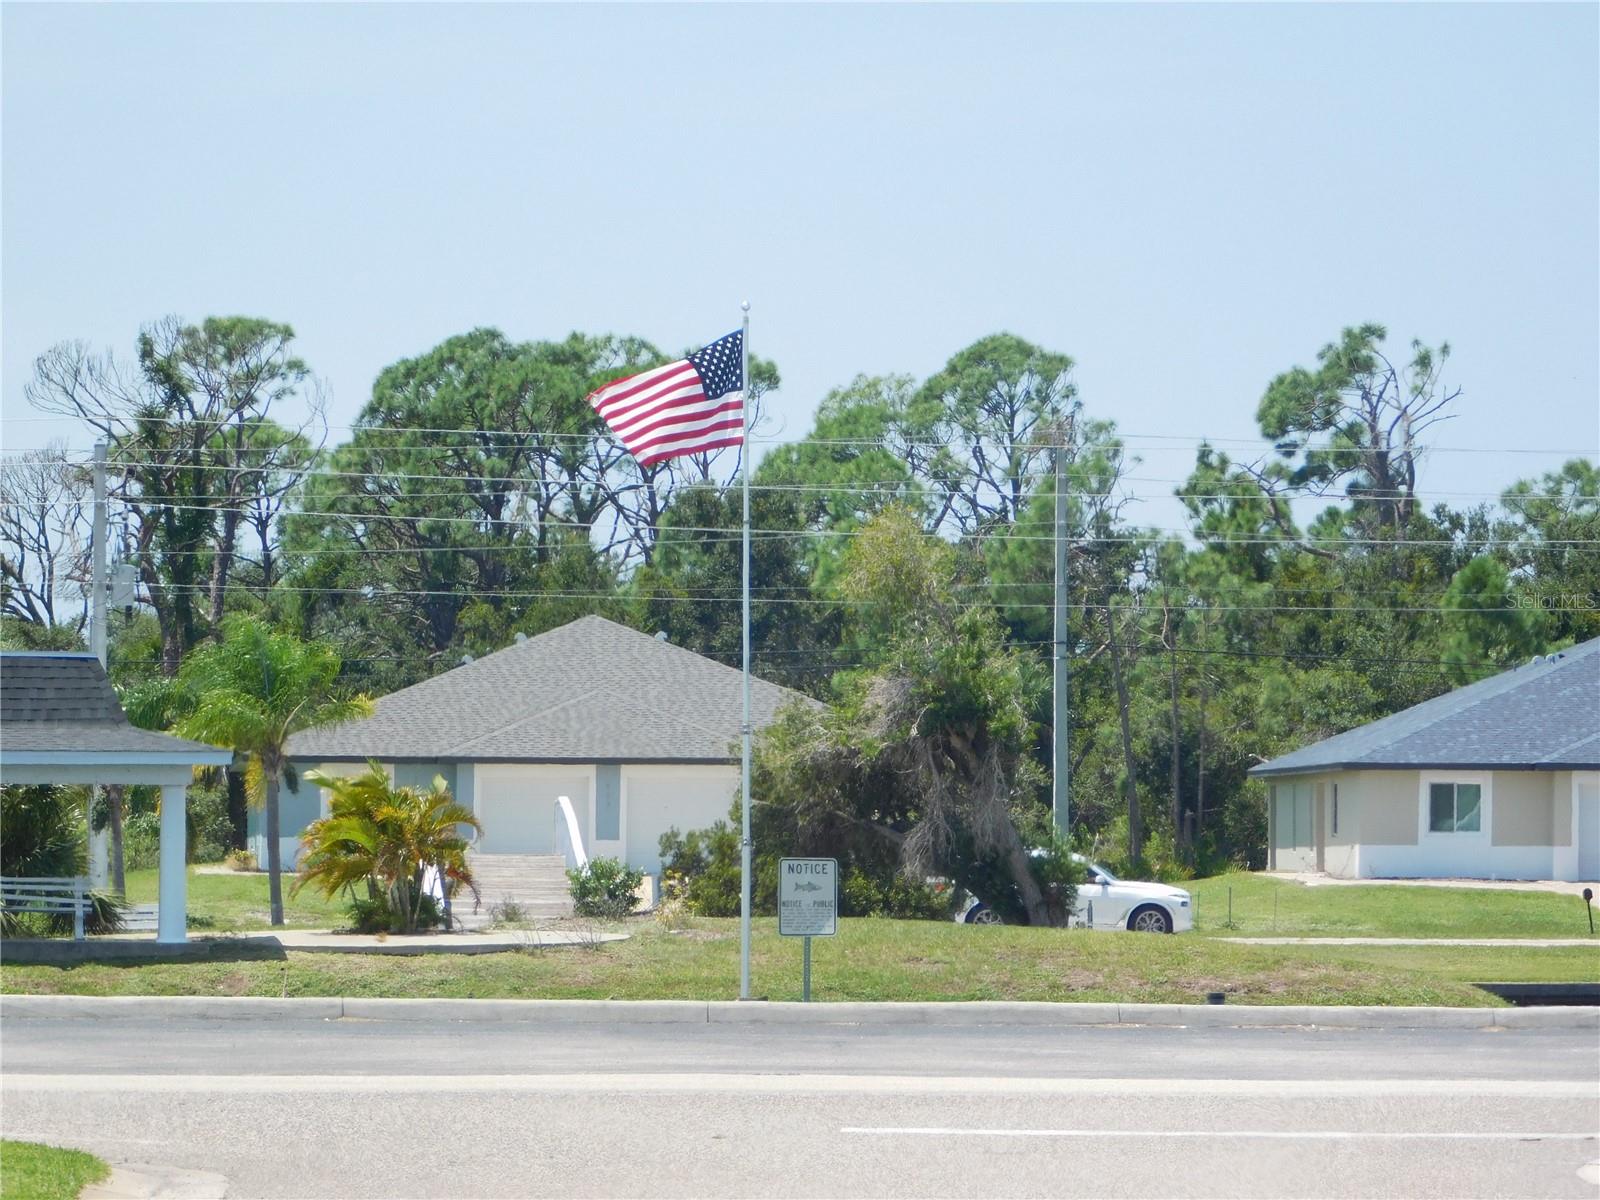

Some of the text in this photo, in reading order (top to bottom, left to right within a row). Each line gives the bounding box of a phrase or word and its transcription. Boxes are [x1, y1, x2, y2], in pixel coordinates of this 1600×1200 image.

[788, 863, 828, 875] NOTICE
[782, 900, 802, 908] NOTICE
[813, 900, 833, 908] PUBLIC
